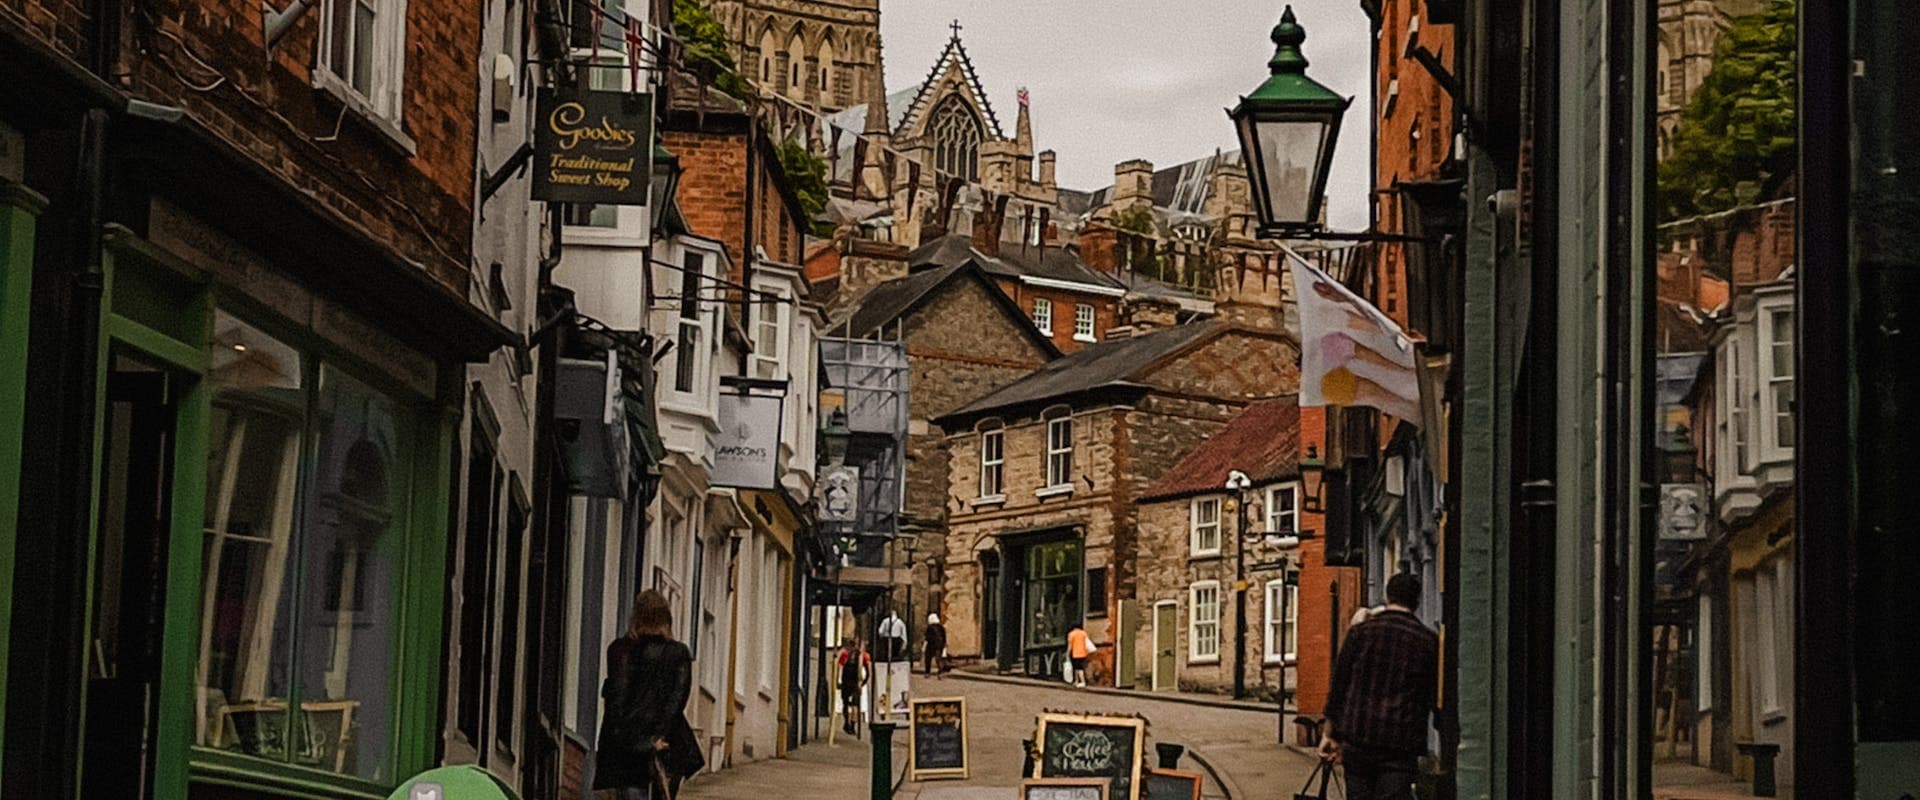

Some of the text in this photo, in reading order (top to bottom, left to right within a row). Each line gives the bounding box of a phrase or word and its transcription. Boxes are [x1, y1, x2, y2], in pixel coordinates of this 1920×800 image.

[550, 102, 635, 149] Goodies
[550, 154, 634, 172] Traditional
[549, 169, 630, 191] Sweet Shop
